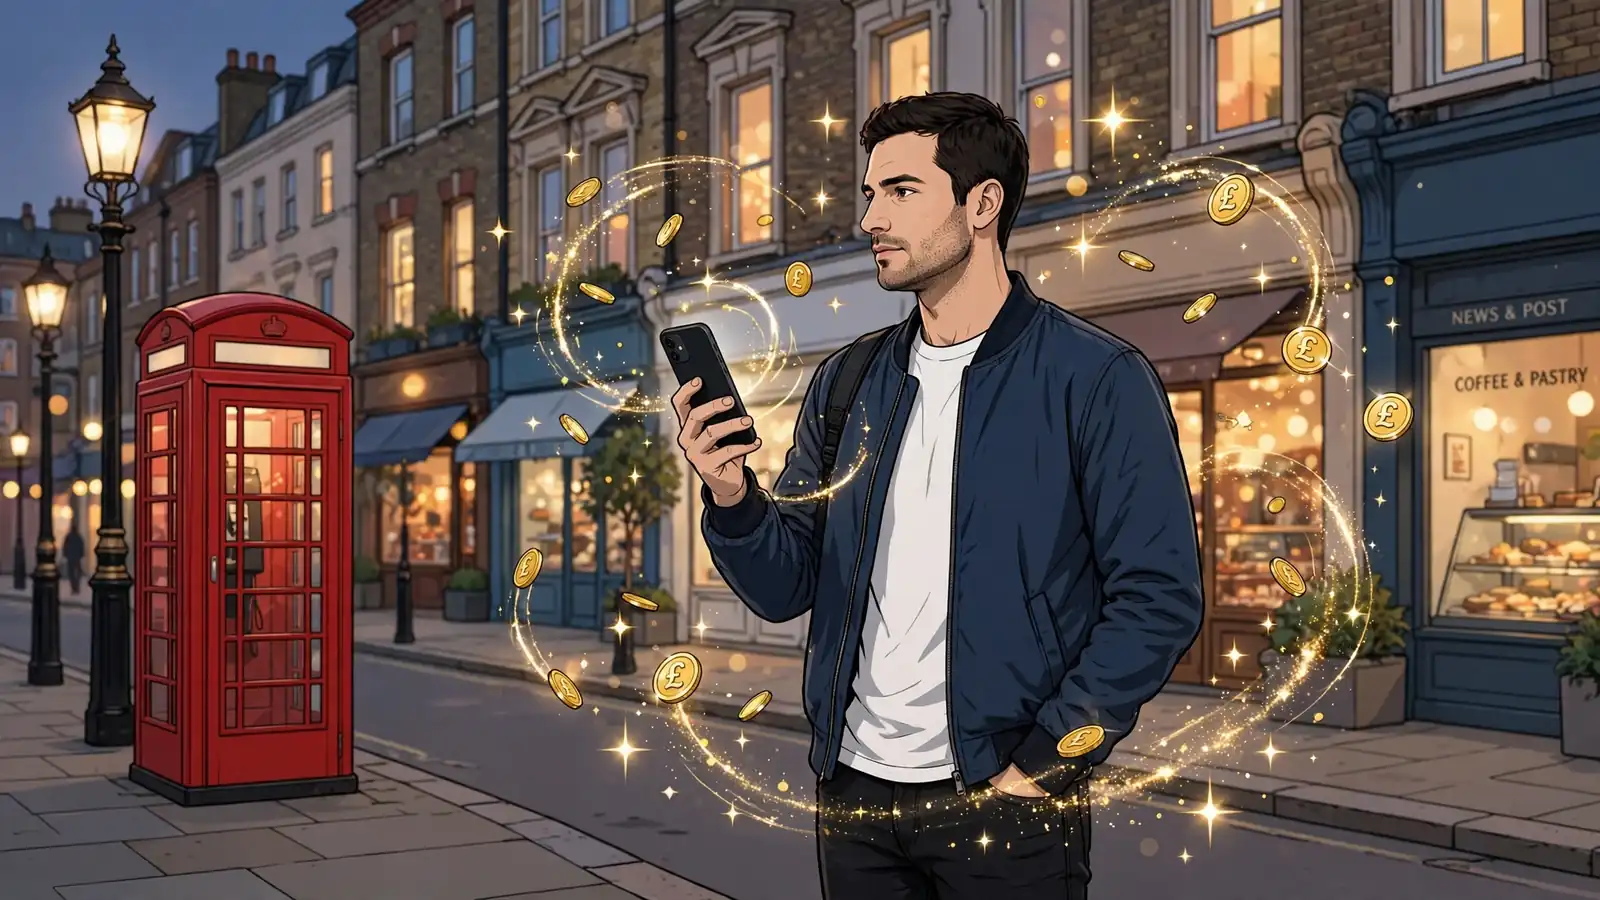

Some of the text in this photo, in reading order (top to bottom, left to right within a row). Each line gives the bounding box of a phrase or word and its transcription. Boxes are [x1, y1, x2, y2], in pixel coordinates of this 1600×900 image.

[1218, 183, 1239, 212] £
[791, 269, 805, 288] £
[1451, 298, 1569, 325] NEWS & POST
[1295, 335, 1318, 363] £
[1454, 367, 1588, 392] COFFEE & PASTRY
[1375, 401, 1398, 428] £
[520, 556, 532, 577] £
[664, 661, 686, 689] £
[1069, 731, 1091, 747] £
